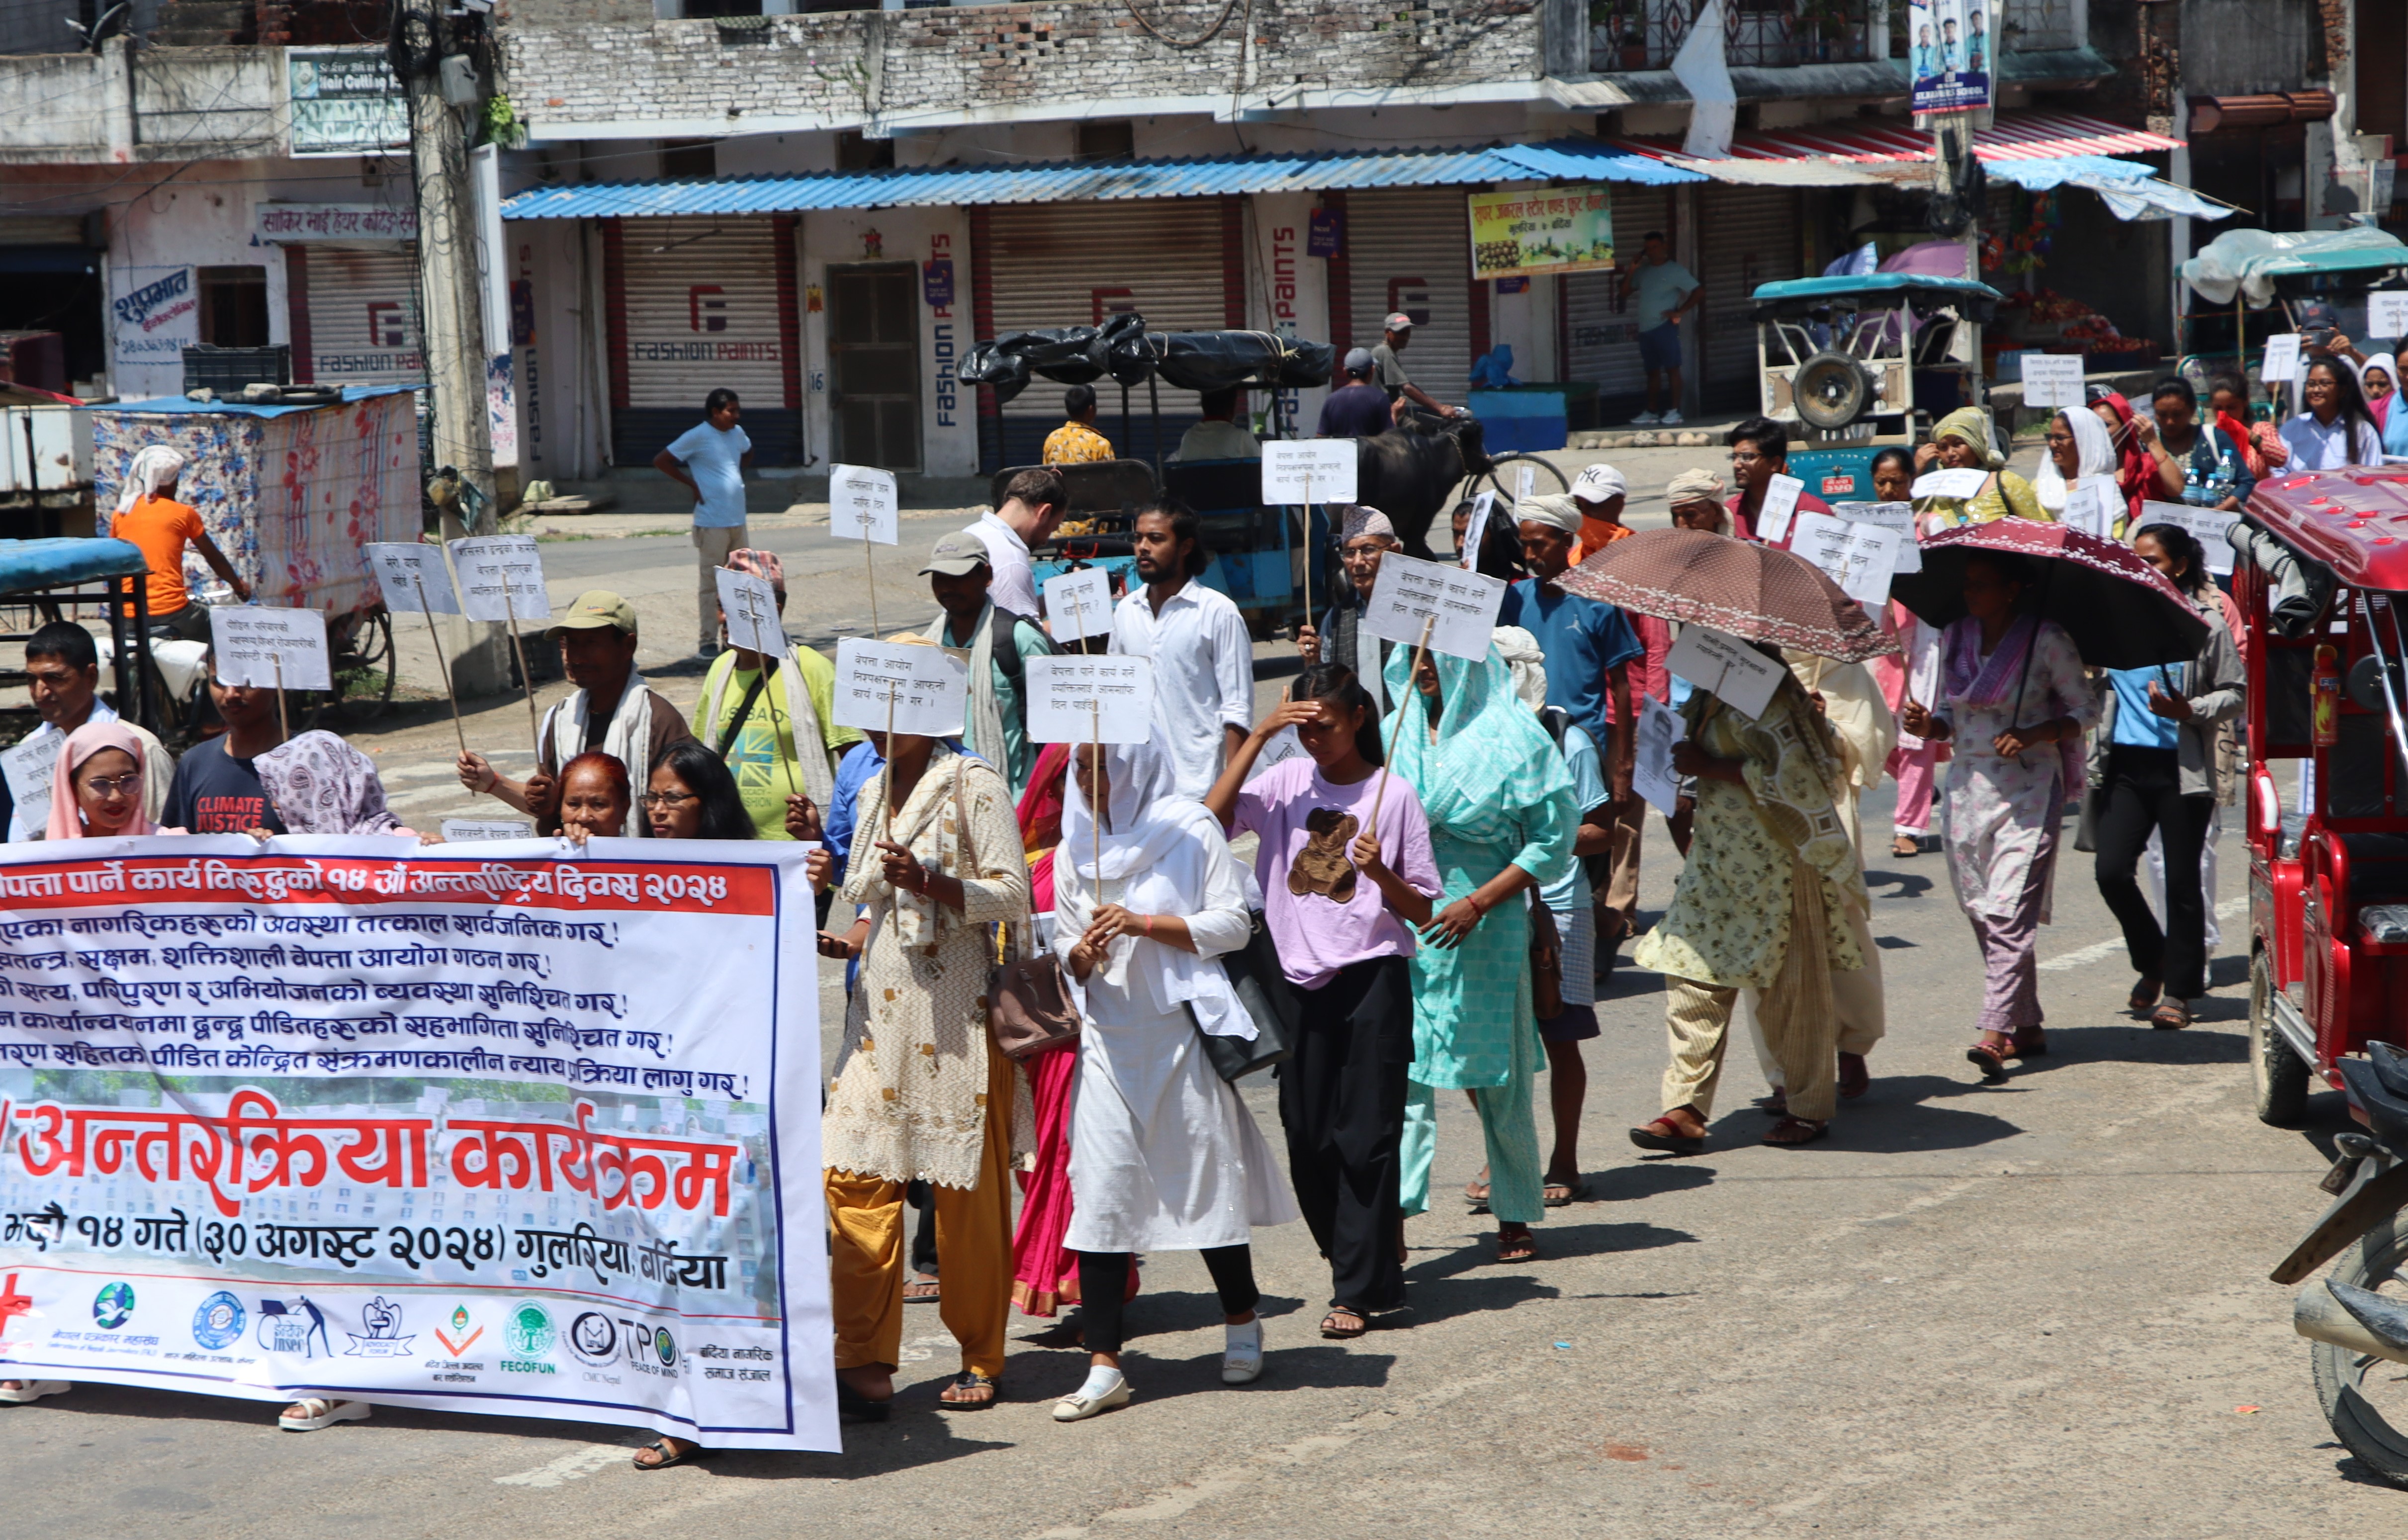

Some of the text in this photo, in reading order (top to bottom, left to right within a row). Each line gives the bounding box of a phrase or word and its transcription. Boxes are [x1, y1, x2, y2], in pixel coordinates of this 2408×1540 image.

[811, 372, 823, 390] 16
[884, 658, 913, 671] आयोग
[196, 797, 265, 814] CLIMATE
[196, 814, 263, 832] JUSTICE
[0, 873, 63, 898] पत्ता
[66, 860, 126, 895] पार्ने
[129, 859, 201, 891] कार्य
[330, 867, 367, 894] १४
[555, 864, 640, 904] दिवस
[644, 873, 728, 907] २०२४
[0, 916, 65, 946] एका
[263, 914, 351, 938] अवस्था
[356, 914, 450, 934] तत्काल
[453, 910, 562, 939] सार्वजनिक
[0, 950, 74, 972] वतन्त्र,
[163, 942, 285, 971] शक्तिशाली
[357, 942, 447, 968] आयोग
[453, 947, 503, 970] गठन
[83, 977, 180, 1006] परिपुरण
[187, 981, 209, 1006] र
[209, 976, 368, 1001] अभियोजनको
[404, 1012, 520, 1039] सहभागिता
[152, 1043, 221, 1068] पीडित
[225, 1045, 309, 1073] केन्द्रित
[509, 1055, 566, 1077] न्याय
[642, 1067, 694, 1098] लागु
[446, 1101, 739, 1218] कार्यक्रम
[77, 1213, 125, 1250] १४
[133, 1206, 190, 1252] गते
[255, 1224, 380, 1269] अगस्ट
[388, 1222, 505, 1271] २०२४)
[733, 1346, 774, 1362] नागरिक
[500, 1360, 556, 1374] FECOFUN
[631, 1360, 679, 1379] PEACE OF MIND
[704, 1367, 735, 1381] समाज
